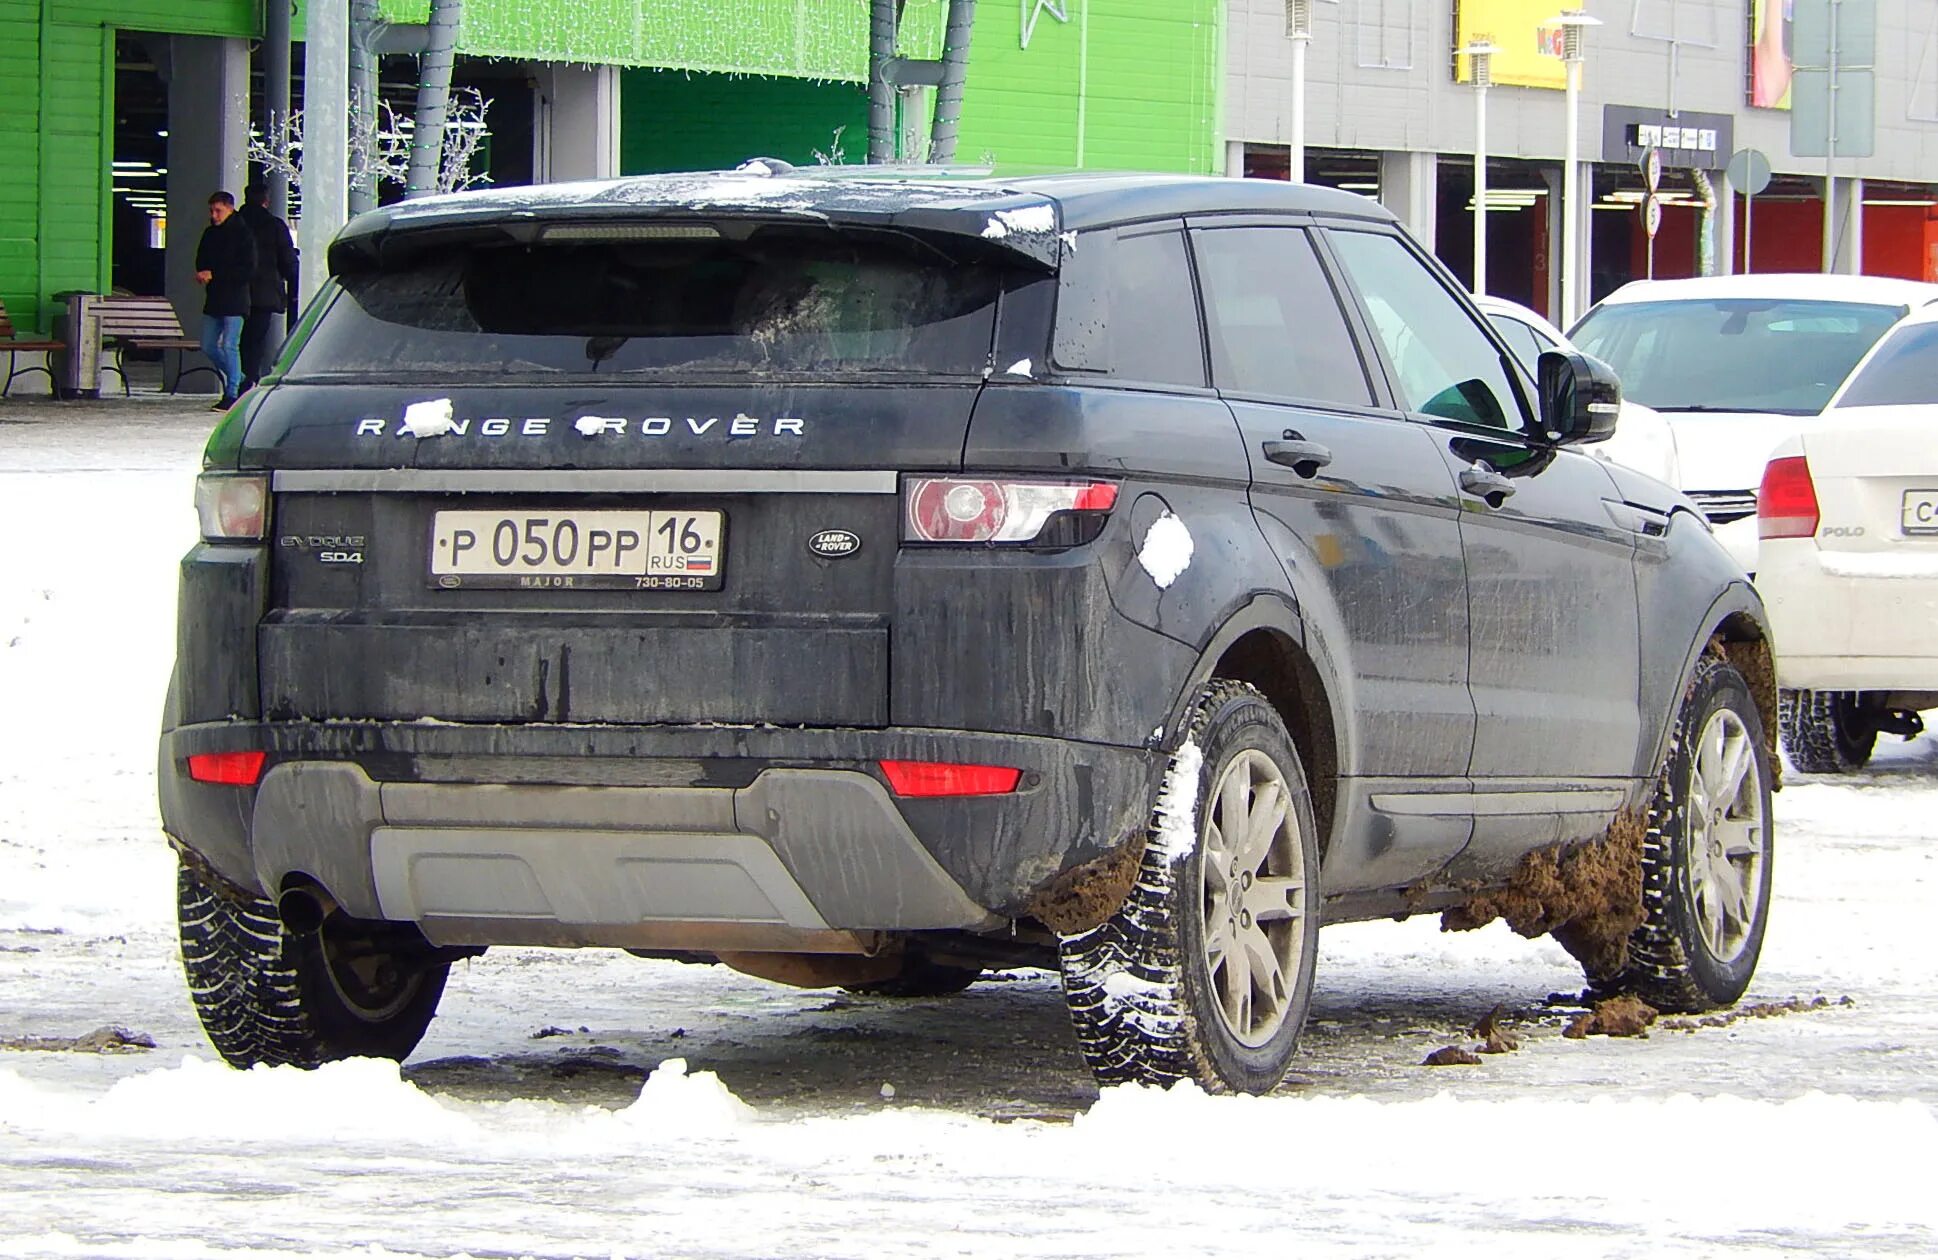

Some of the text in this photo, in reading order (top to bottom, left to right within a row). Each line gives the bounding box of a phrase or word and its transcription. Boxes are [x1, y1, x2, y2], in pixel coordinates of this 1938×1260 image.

[356, 416, 804, 436] RNGE ROVER
[658, 517, 702, 554] 16
[1822, 526, 1865, 538] POLO
[280, 535, 365, 548] EVOQUE
[320, 551, 364, 563] SD4
[651, 555, 685, 569] RUS
[520, 576, 574, 587] MAJOR
[634, 577, 704, 588] 730-80-05
